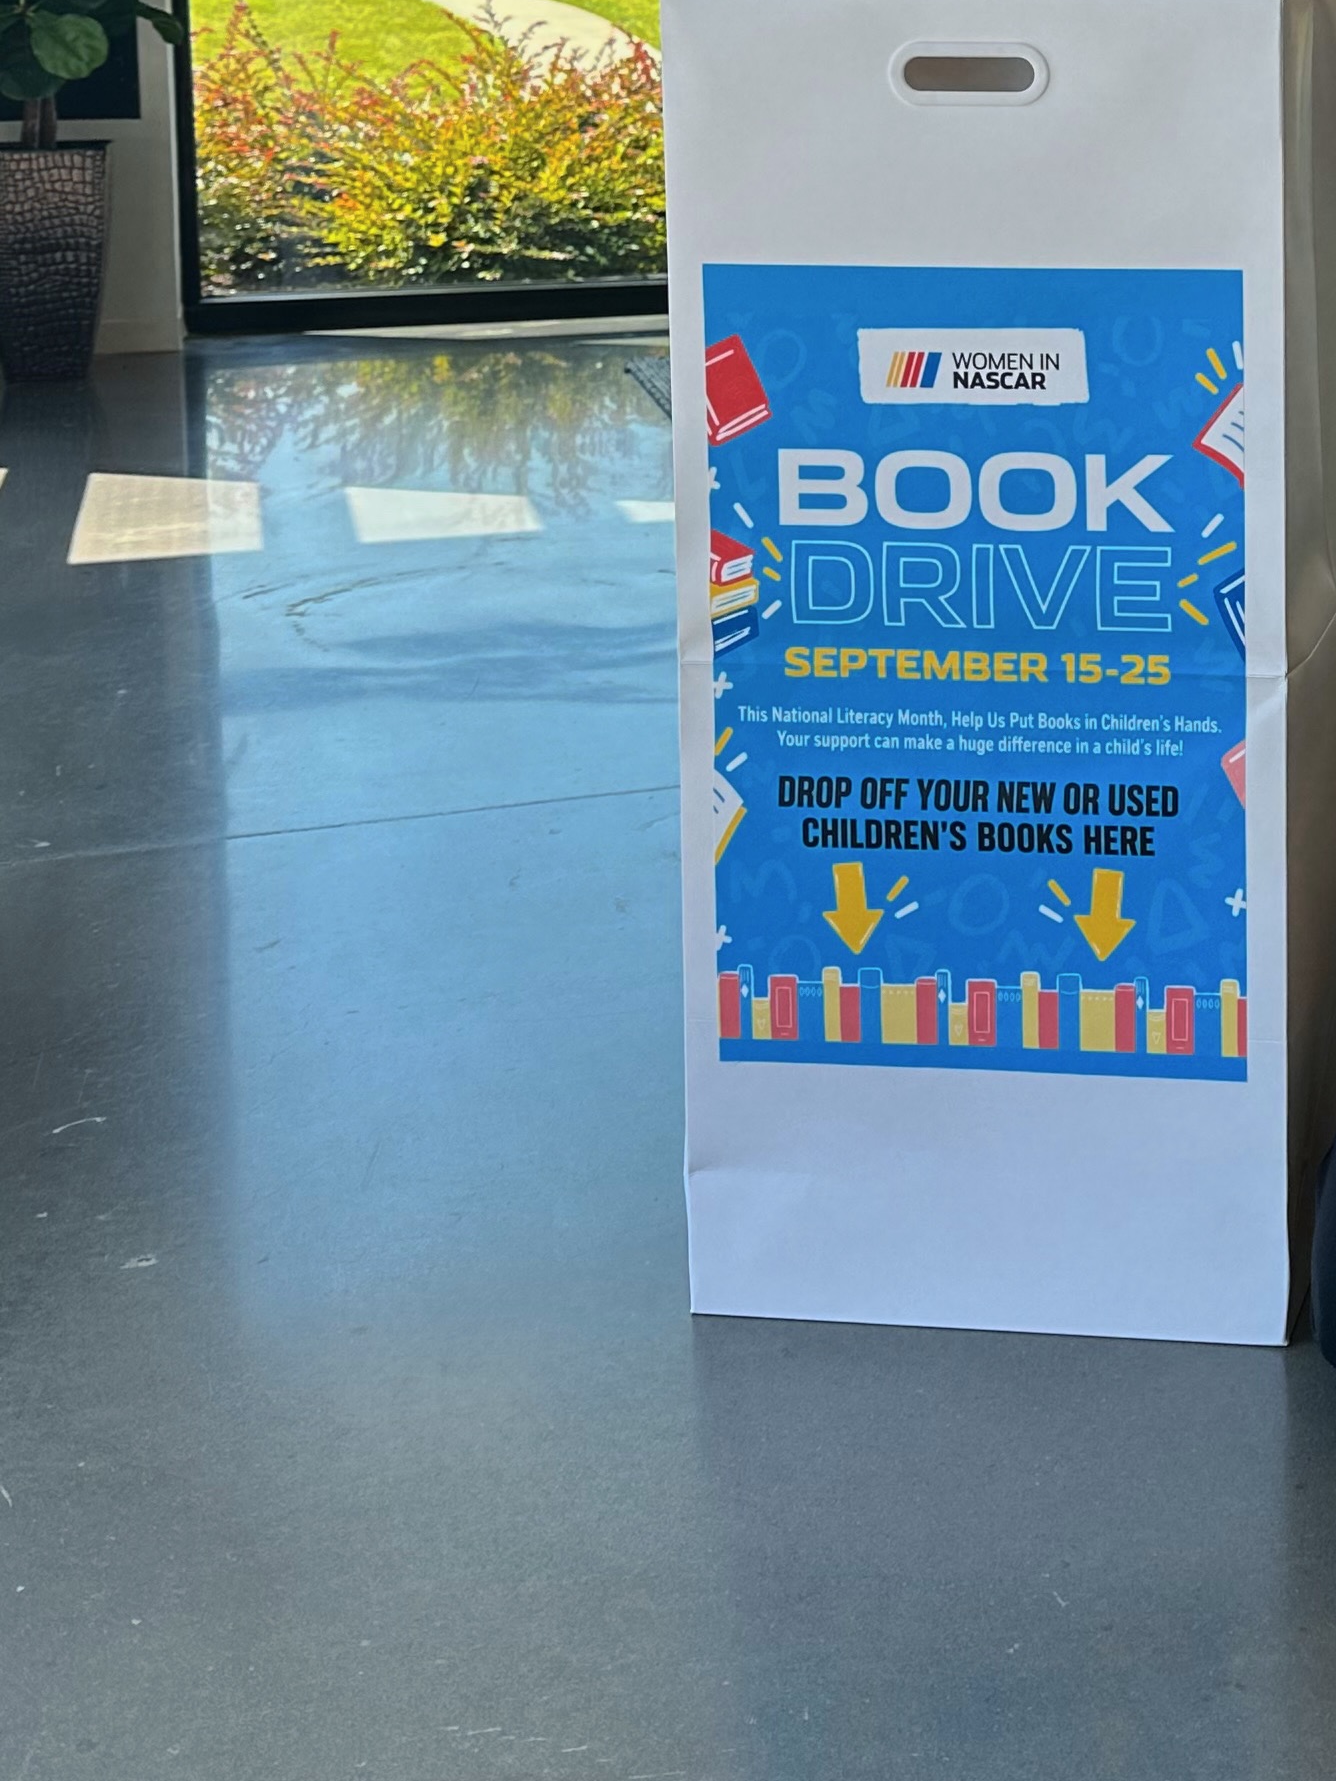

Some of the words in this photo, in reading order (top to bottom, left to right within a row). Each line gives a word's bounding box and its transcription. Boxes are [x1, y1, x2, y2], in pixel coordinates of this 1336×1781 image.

[952, 352, 1035, 371] WOMEN
[1040, 353, 1060, 371] IN
[952, 371, 1046, 390] NASCAR
[777, 448, 1175, 532] BOOK
[790, 539, 1172, 632] DRIVE
[785, 647, 1047, 681] SEPTEMBER
[1062, 653, 1170, 684] 15-25
[738, 706, 768, 722] This
[773, 707, 832, 723] National
[838, 708, 893, 728] Literacy
[898, 708, 947, 728] Month,
[952, 711, 983, 731] Help
[988, 712, 1005, 729] Us
[1010, 713, 1033, 728] Put
[1039, 713, 1080, 729] Books
[1085, 715, 1097, 730] in
[1102, 714, 1170, 731] Children's
[1175, 716, 1221, 733] Hands.
[777, 731, 810, 746] Your
[815, 734, 870, 751] support
[875, 737, 899, 748] can
[904, 734, 942, 749] make
[947, 739, 954, 750] a
[959, 735, 993, 755] huge
[999, 736, 1071, 753] difference
[1076, 738, 1088, 753] in
[1093, 742, 1101, 753] a
[1106, 737, 1151, 756] child's
[1157, 740, 1182, 756] life!
[779, 776, 852, 808] DROP
[861, 777, 909, 810] OFF
[917, 779, 989, 812] YOUR
[997, 781, 1056, 814] NEW
[1064, 783, 1099, 815] OR
[1109, 784, 1178, 817] USED
[803, 818, 966, 851] CHILDREN'S
[978, 822, 1072, 854] BOOKS
[1084, 825, 1155, 856] HERE
